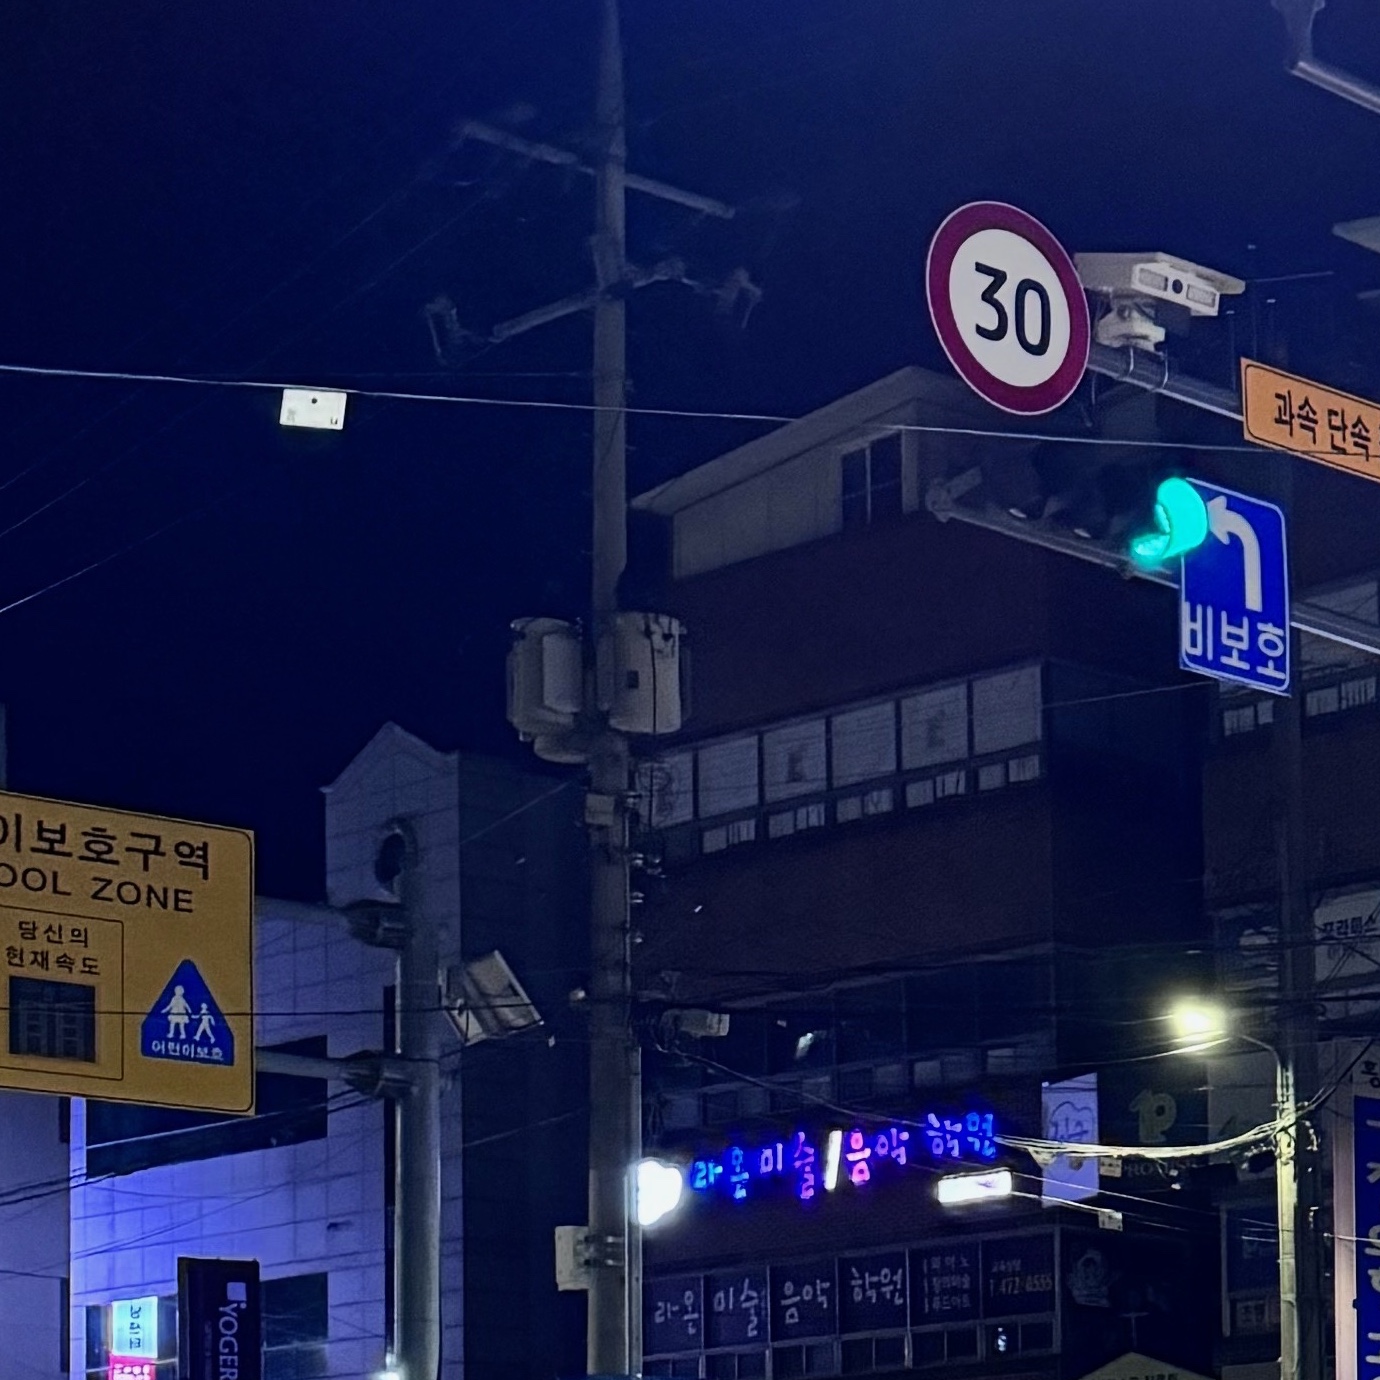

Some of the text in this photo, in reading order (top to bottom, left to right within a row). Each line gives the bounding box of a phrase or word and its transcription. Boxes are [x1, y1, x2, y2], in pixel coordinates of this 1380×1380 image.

[974, 261, 1051, 357] 30
[1274, 391, 1319, 445] 과속
[1327, 408, 1372, 463] 단속
[1182, 602, 1287, 679] 비보호
[91, 873, 194, 914] ZONE
[18, 921, 88, 949] 당신의
[5, 946, 100, 977] 현재속도
[152, 1040, 224, 1062] 어린이보호
[926, 1111, 997, 1159] 학원
[655, 1289, 699, 1336] 라온
[713, 1277, 759, 1337] 미술
[780, 1280, 831, 1325] 음악
[850, 1266, 906, 1306] 학원
